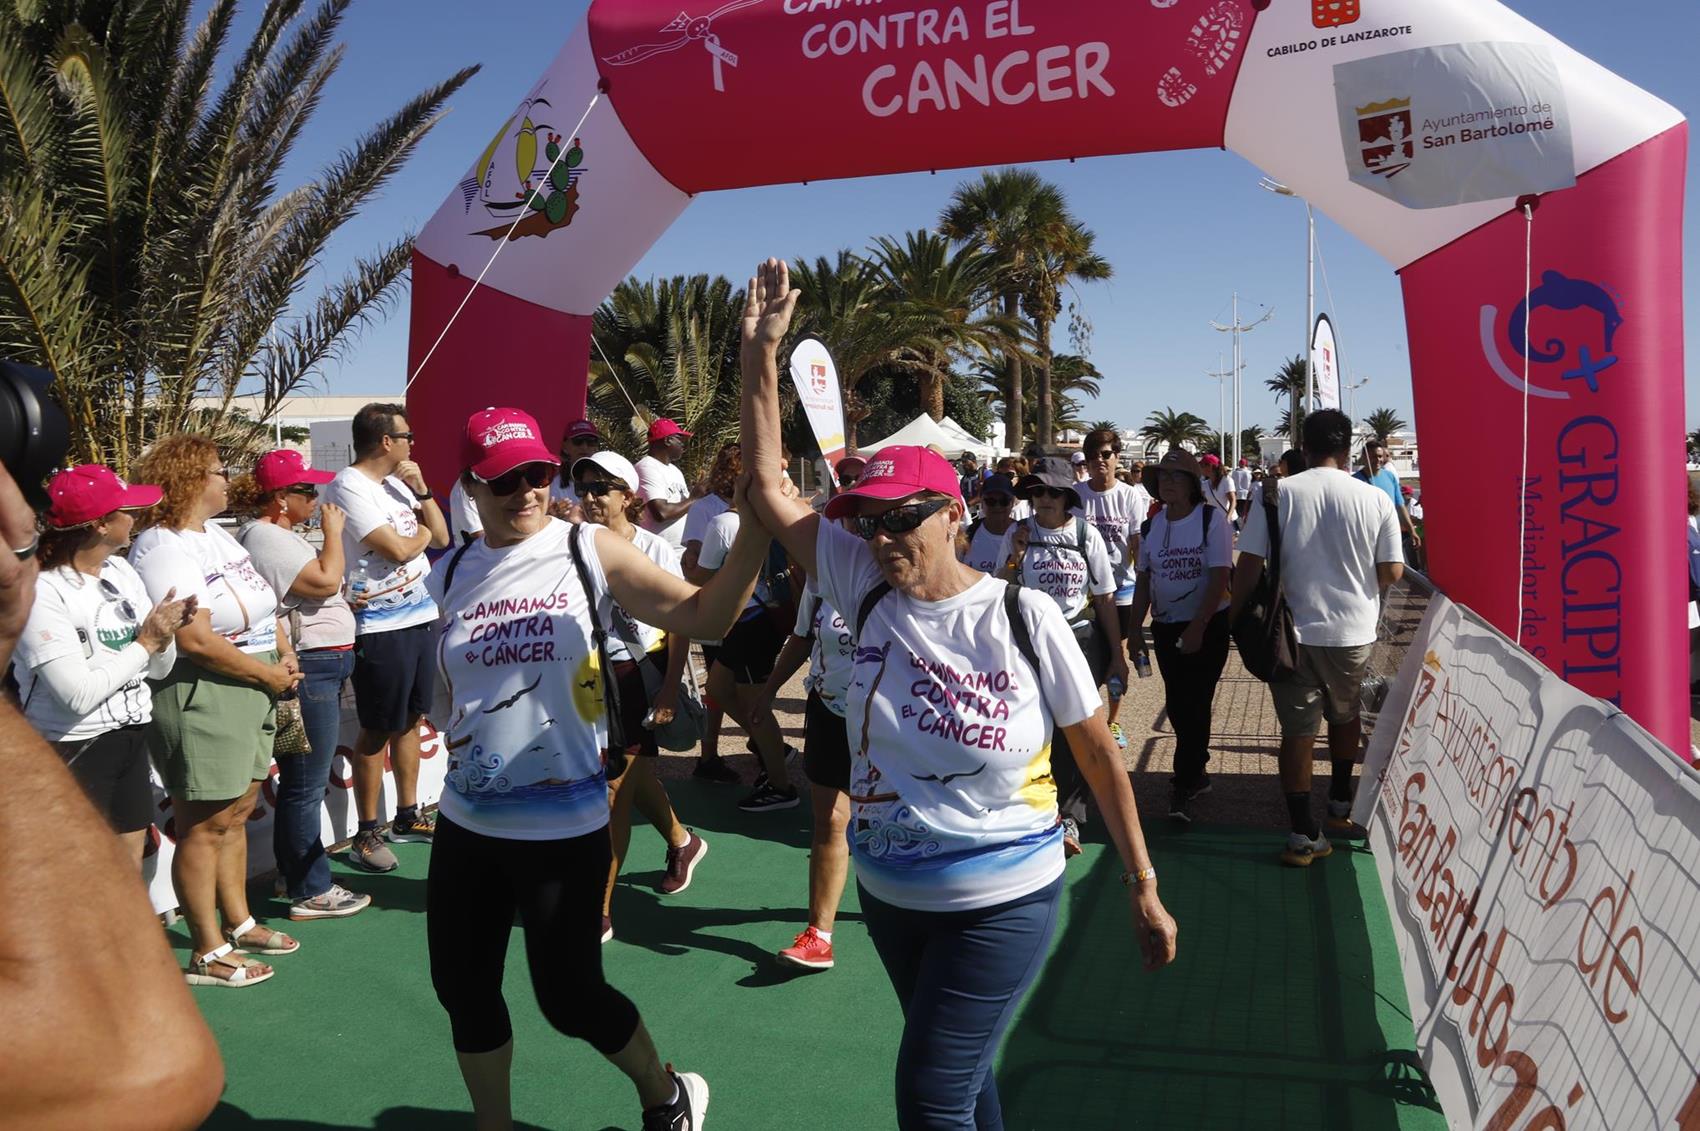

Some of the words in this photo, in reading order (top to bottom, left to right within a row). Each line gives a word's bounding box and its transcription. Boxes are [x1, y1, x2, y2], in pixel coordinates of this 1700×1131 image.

[802, 6, 969, 59] CONTRA
[985, 0, 1035, 40] EL
[1267, 40, 1317, 58] CABILDO
[1322, 36, 1337, 47] DE
[1340, 25, 1412, 44] LANZAROTE
[862, 42, 1116, 118] CANCER
[1421, 104, 1528, 132] Ayuntamiento
[1532, 101, 1551, 114] de
[1423, 132, 1456, 149] San
[1460, 117, 1555, 142] Bartolomé
[1516, 474, 1545, 600] Mediador
[1162, 557, 1202, 569] CONTRA
[1556, 415, 1622, 708] GRACIPL
[1038, 572, 1083, 585] CONTRA
[470, 615, 554, 644] CONTRA
[1520, 608, 1547, 637] de
[465, 650, 479, 664] EL
[901, 704, 918, 719] EL
[910, 678, 1010, 721] CONTRA
[1399, 771, 1436, 881] San
[1577, 869, 1644, 1024] de
